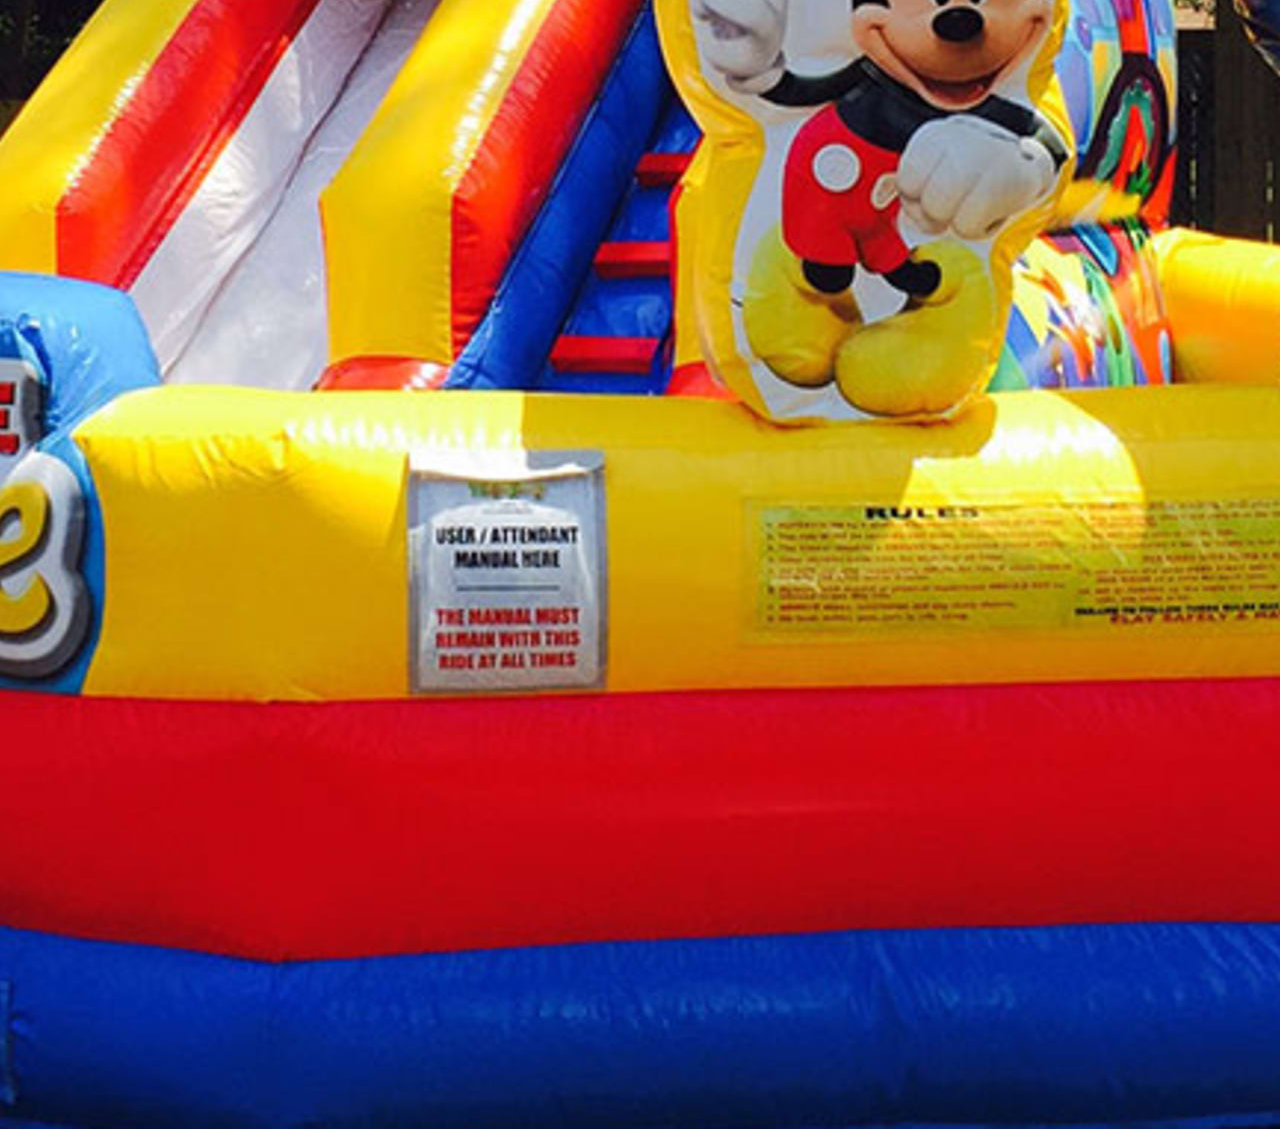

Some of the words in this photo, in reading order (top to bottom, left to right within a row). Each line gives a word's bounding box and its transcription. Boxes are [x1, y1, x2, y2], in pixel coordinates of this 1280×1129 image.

[864, 506, 979, 520] RULES
[435, 526, 475, 544] USER
[480, 527, 487, 544] /
[489, 525, 579, 544] ATTENDANT
[454, 550, 519, 568] MANUAL
[521, 550, 560, 568] HERE
[436, 608, 464, 625] THE
[468, 607, 531, 624] MANUAL
[536, 607, 580, 624] MUST
[435, 631, 495, 648] REMAIN
[499, 631, 540, 647] WITH
[545, 630, 581, 646] THIS
[438, 654, 474, 669] RIDE
[478, 654, 497, 668] AT
[500, 653, 525, 668] ALL
[530, 652, 576, 667] TIMES
